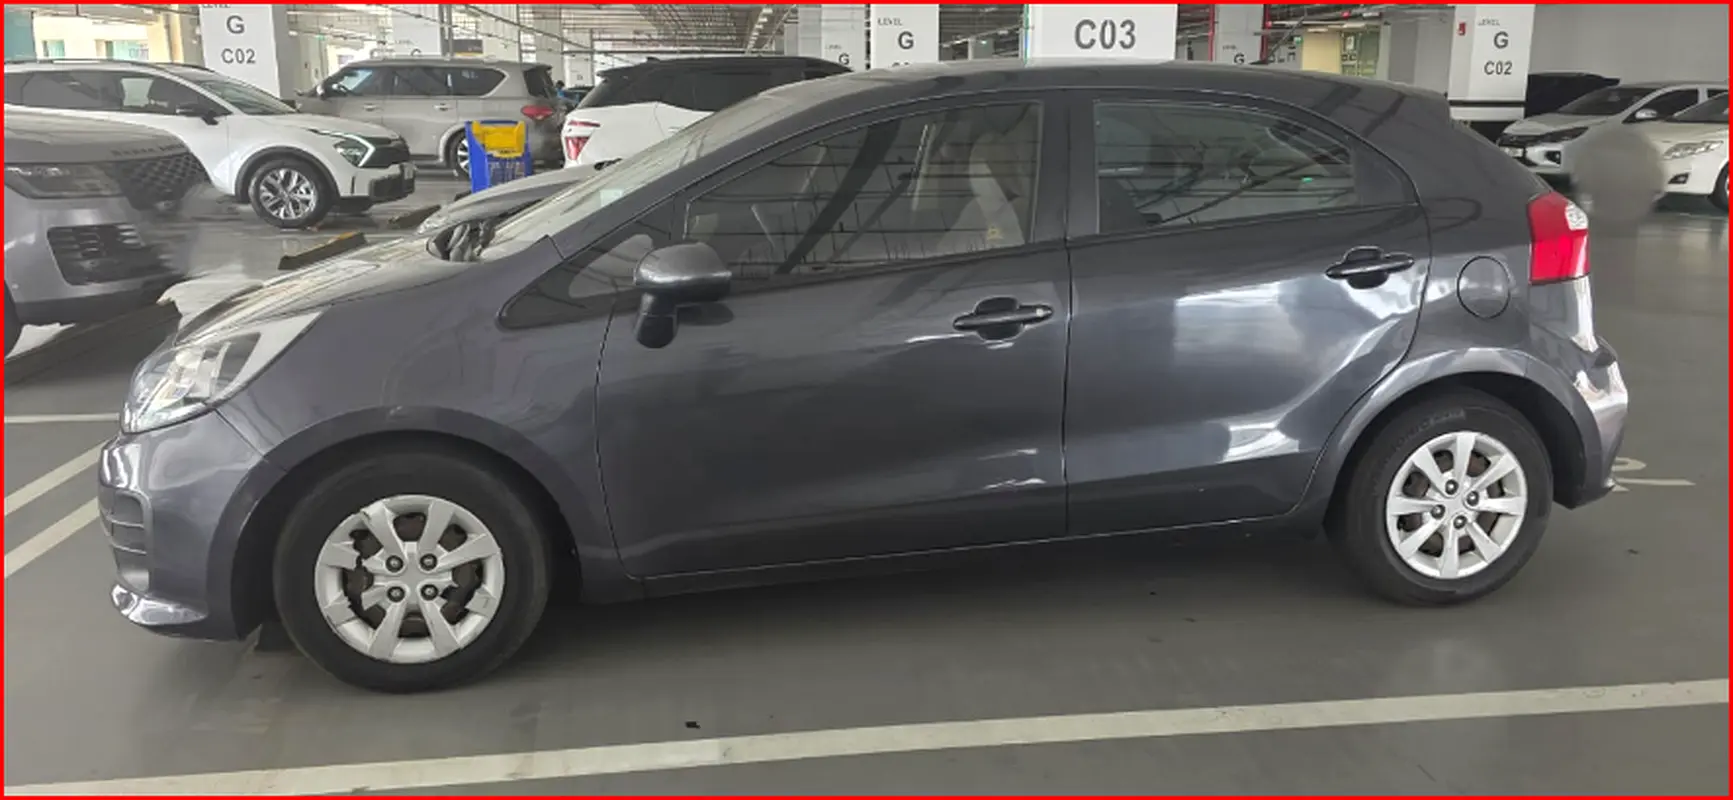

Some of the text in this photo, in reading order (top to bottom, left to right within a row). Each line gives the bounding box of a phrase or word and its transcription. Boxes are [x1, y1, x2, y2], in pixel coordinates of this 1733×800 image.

[226, 15, 245, 34] G
[898, 31, 914, 50] G
[1074, 19, 1136, 49] C03
[1493, 31, 1509, 49] G
[221, 48, 256, 64] C02
[838, 53, 850, 66] G
[1233, 53, 1245, 64] G
[1483, 60, 1513, 75] C02
